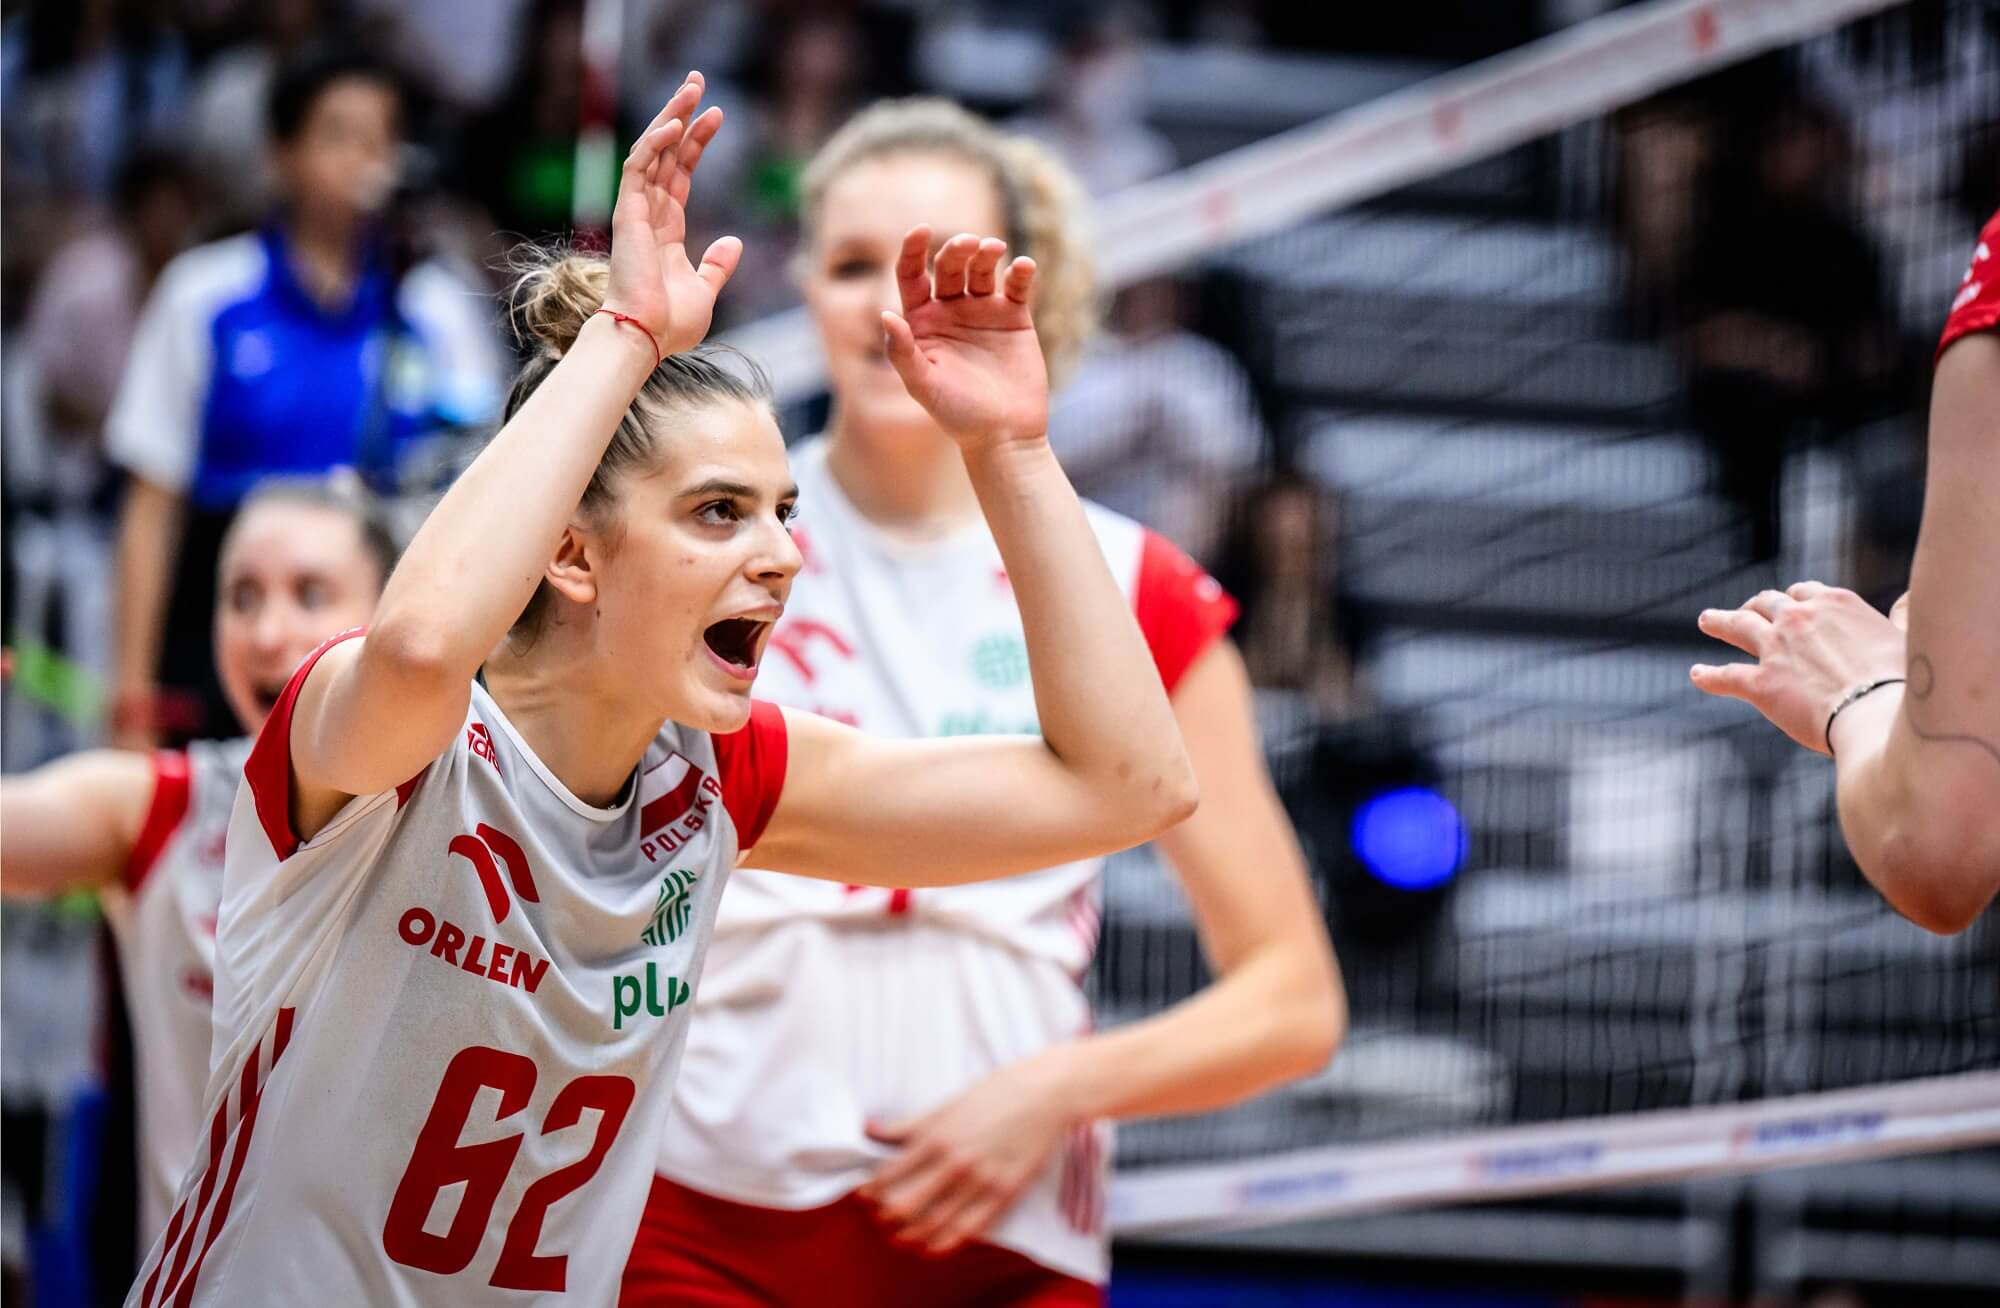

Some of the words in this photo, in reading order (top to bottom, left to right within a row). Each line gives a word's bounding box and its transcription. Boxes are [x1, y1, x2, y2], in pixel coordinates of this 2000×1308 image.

[640, 776, 721, 862] POLSKA
[398, 907, 549, 993] ORLEN
[383, 1046, 636, 1292] 62
